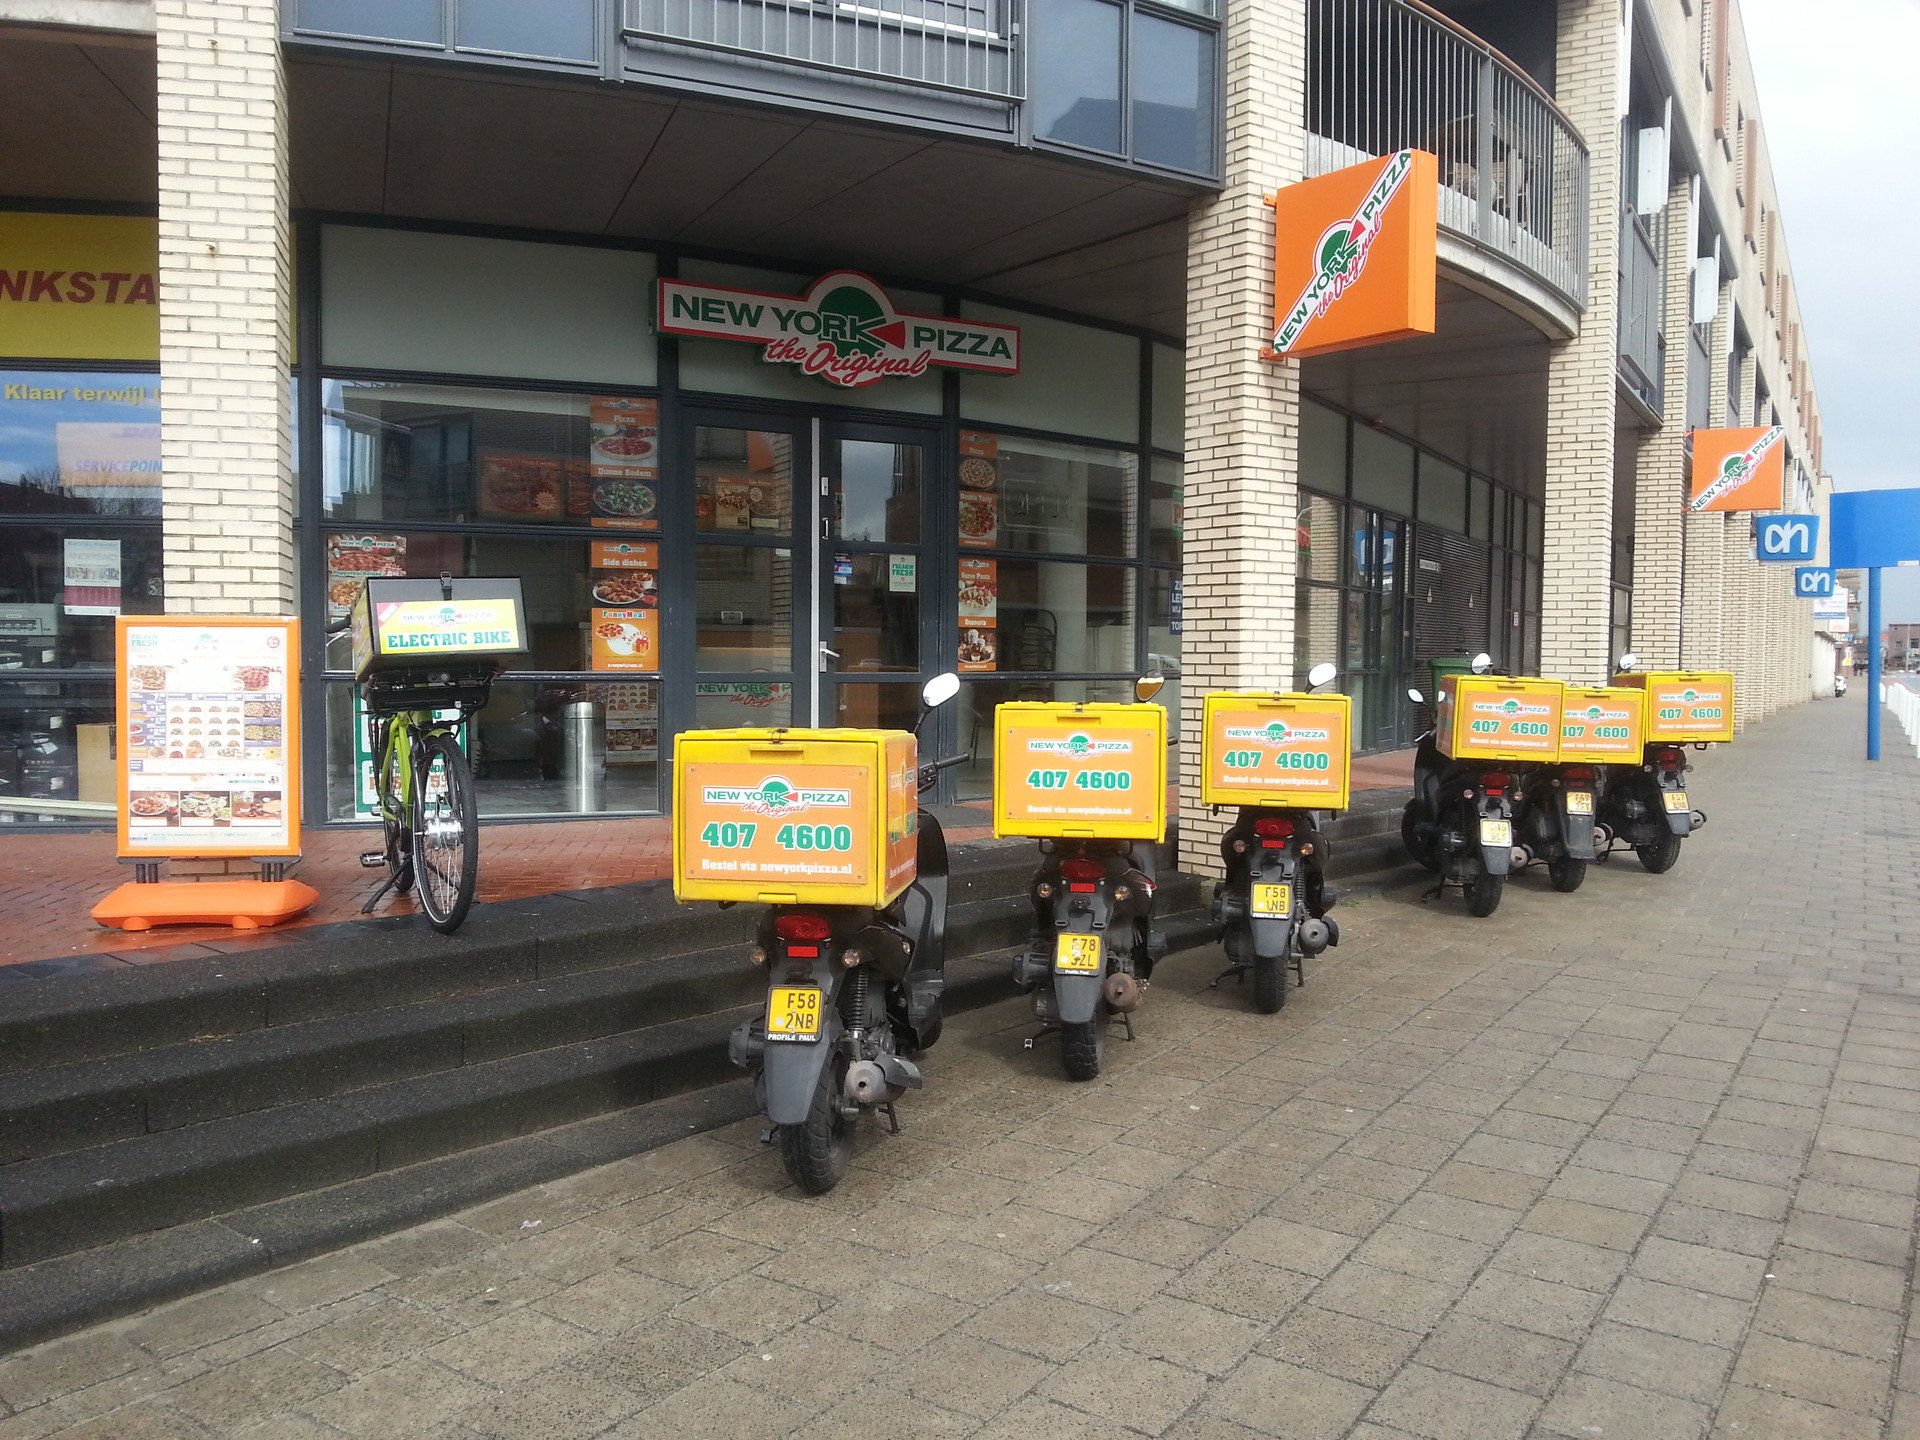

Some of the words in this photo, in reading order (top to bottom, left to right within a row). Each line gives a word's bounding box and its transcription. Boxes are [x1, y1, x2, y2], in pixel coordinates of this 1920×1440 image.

[1274, 304, 1308, 353] NEW
[1307, 231, 1358, 301] YORK
[1362, 152, 1411, 220] PIZZA
[1317, 291, 1334, 316] the
[1334, 211, 1380, 297] Original
[672, 294, 764, 328] NEW
[771, 306, 887, 350] YORK
[914, 326, 1012, 360] PIZZA
[765, 337, 808, 362] the
[804, 343, 932, 384] Original
[4, 384, 66, 402] Klaar
[72, 386, 145, 406] terwijl
[1692, 488, 1715, 510] NEW
[1716, 457, 1750, 488] YORK
[1752, 426, 1783, 455] PIZZA
[388, 632, 467, 648] ELECTRIC
[473, 630, 511, 645] BIKE
[698, 684, 729, 692] NEW
[732, 684, 772, 695] YORK
[1660, 709, 1682, 718] 407
[1691, 708, 1722, 718] 4600
[1254, 730, 1286, 738] YORK
[1472, 720, 1500, 733] 407
[1510, 722, 1548, 736] 4600
[1594, 727, 1628, 739] 4600
[1056, 742, 1088, 751] YORK
[1224, 751, 1262, 768] 407
[1276, 752, 1328, 770] 4600
[1028, 771, 1068, 788] 407
[1076, 772, 1130, 789] 4600
[706, 790, 743, 800] NEW
[745, 791, 790, 803] YORK
[802, 793, 847, 803] PIZZA
[757, 802, 809, 817] Original
[702, 823, 756, 849] 407
[776, 825, 851, 850] 4600
[702, 858, 737, 870] Bestel
[740, 860, 757, 872] via
[760, 862, 852, 876] newyorkpizza.nl
[1266, 887, 1286, 898] F58
[788, 993, 816, 1009] F58
[785, 1013, 814, 1029] 2NB
